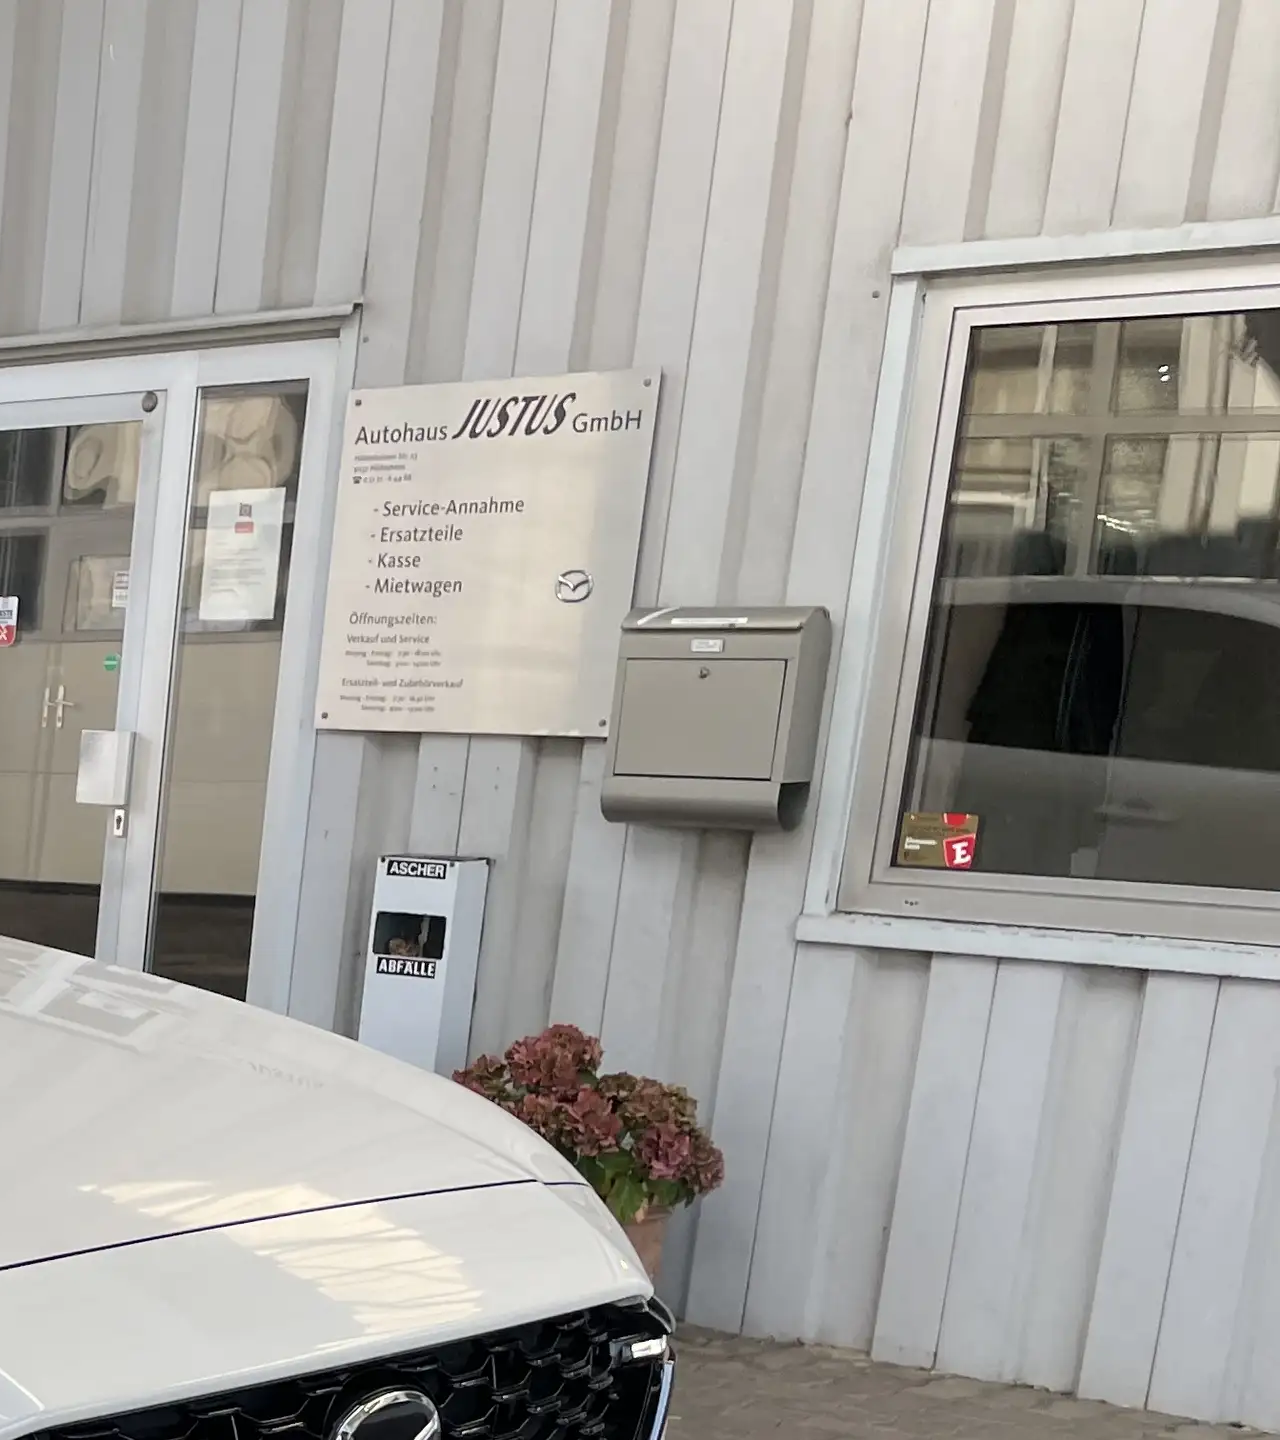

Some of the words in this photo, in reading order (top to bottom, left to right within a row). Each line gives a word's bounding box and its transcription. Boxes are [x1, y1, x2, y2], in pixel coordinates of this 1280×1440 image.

[354, 422, 448, 445] Autohaus
[451, 392, 577, 439] JUSTUS
[572, 410, 643, 433] GmbH
[382, 496, 525, 517] Service-Annahme
[380, 524, 464, 543] Ersatzteile
[377, 553, 421, 568] Kasse
[374, 577, 463, 598] Mietwagen
[389, 861, 445, 878] ASCHER
[378, 958, 435, 977] ABFÄLLE
